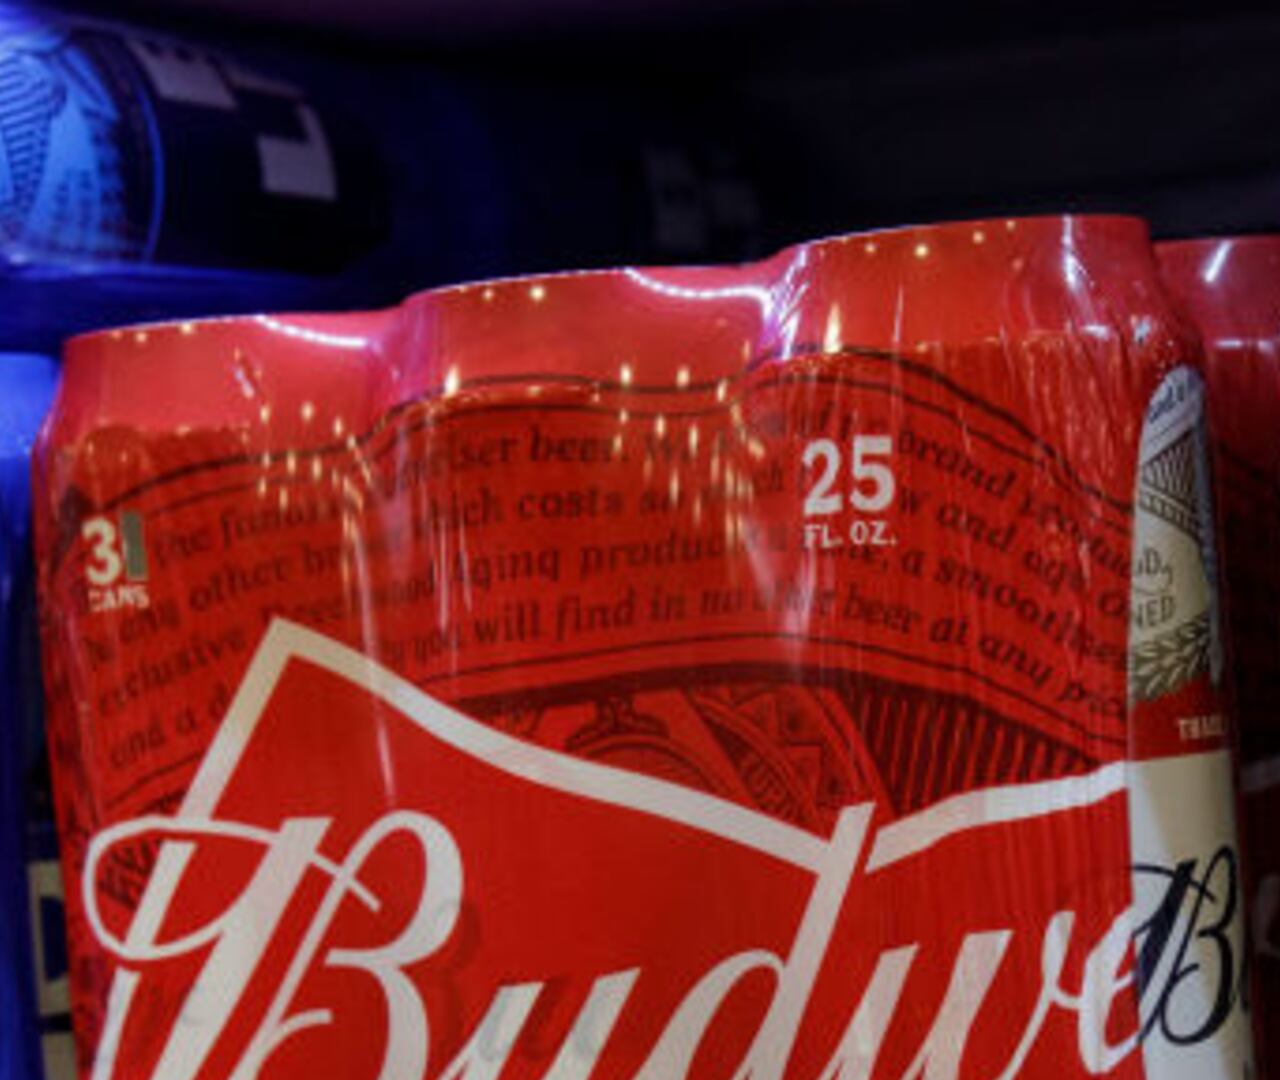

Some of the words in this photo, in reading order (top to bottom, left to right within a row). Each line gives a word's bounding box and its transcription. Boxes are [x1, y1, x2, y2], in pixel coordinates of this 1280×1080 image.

[800, 435, 897, 517] 25
[82, 517, 123, 586] 3
[473, 599, 542, 646] will
[555, 587, 638, 643] find
[929, 613, 968, 649] at
